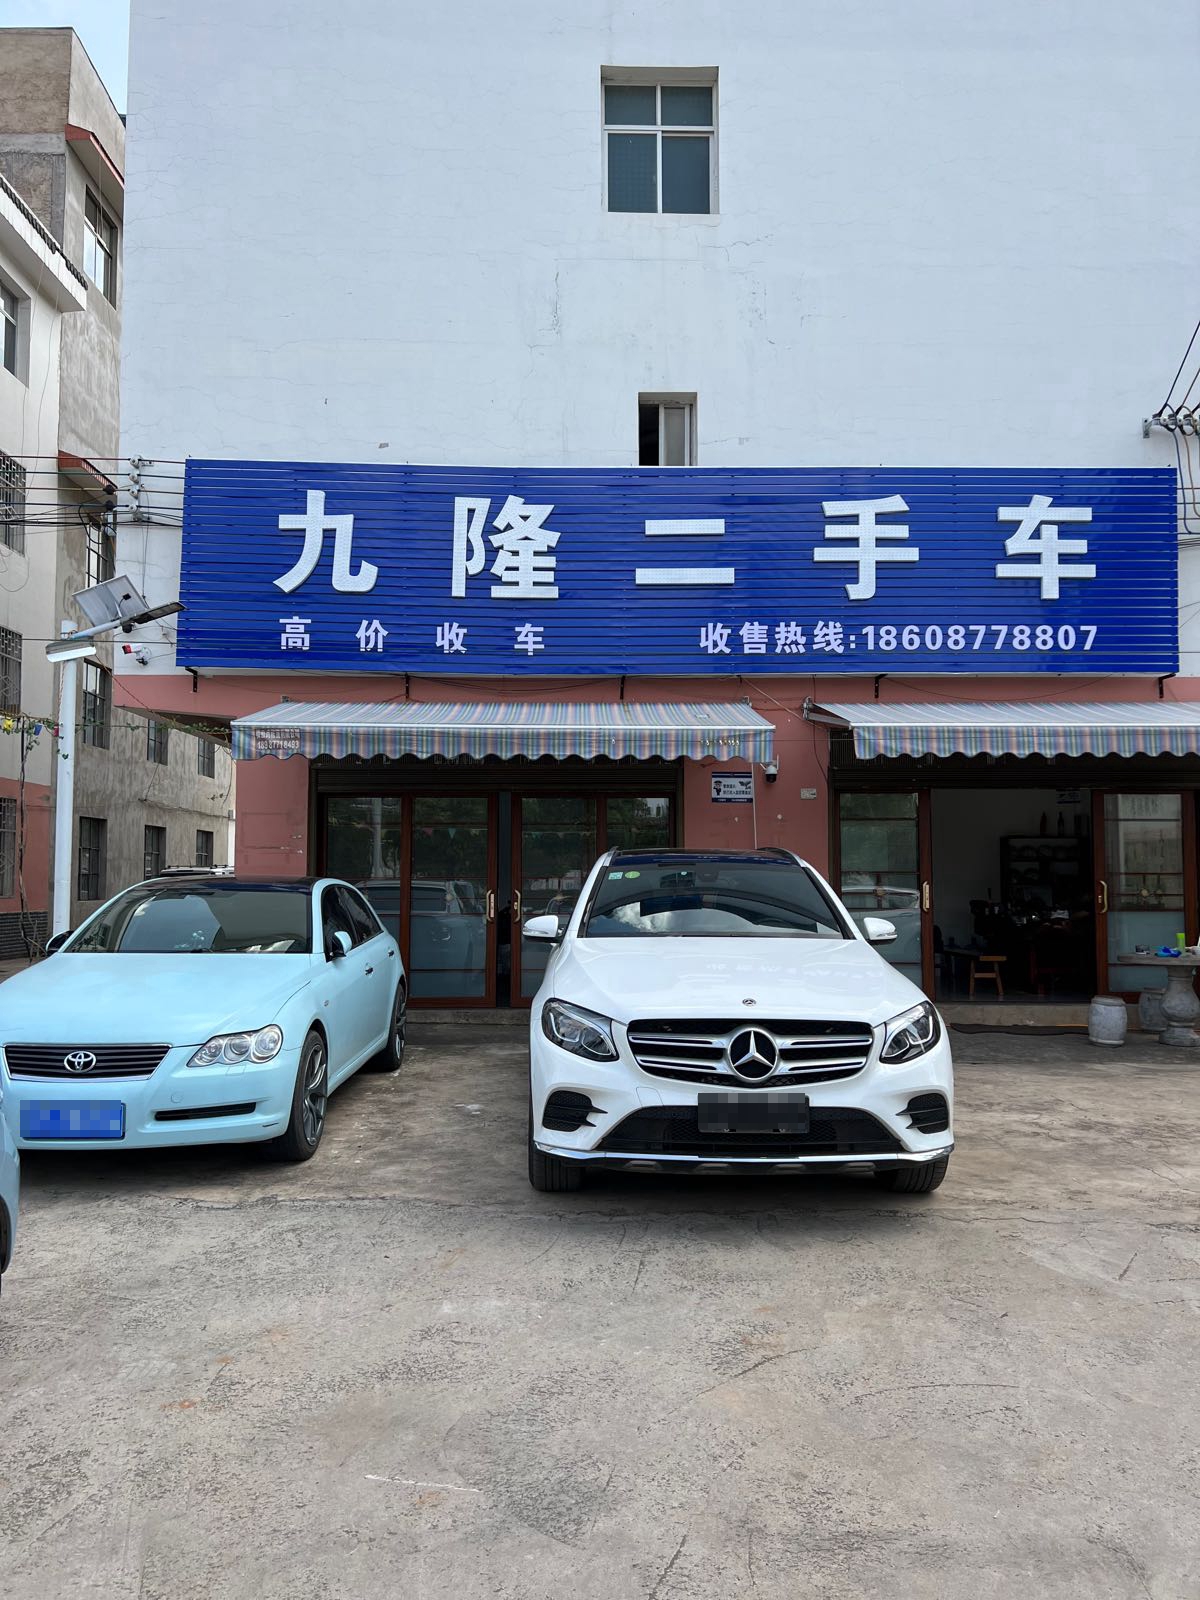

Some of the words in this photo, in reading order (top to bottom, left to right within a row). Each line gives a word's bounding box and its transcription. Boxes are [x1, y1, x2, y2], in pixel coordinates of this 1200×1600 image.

[272, 489, 1097, 600] 九隆二手车
[279, 615, 545, 654] 高价收车
